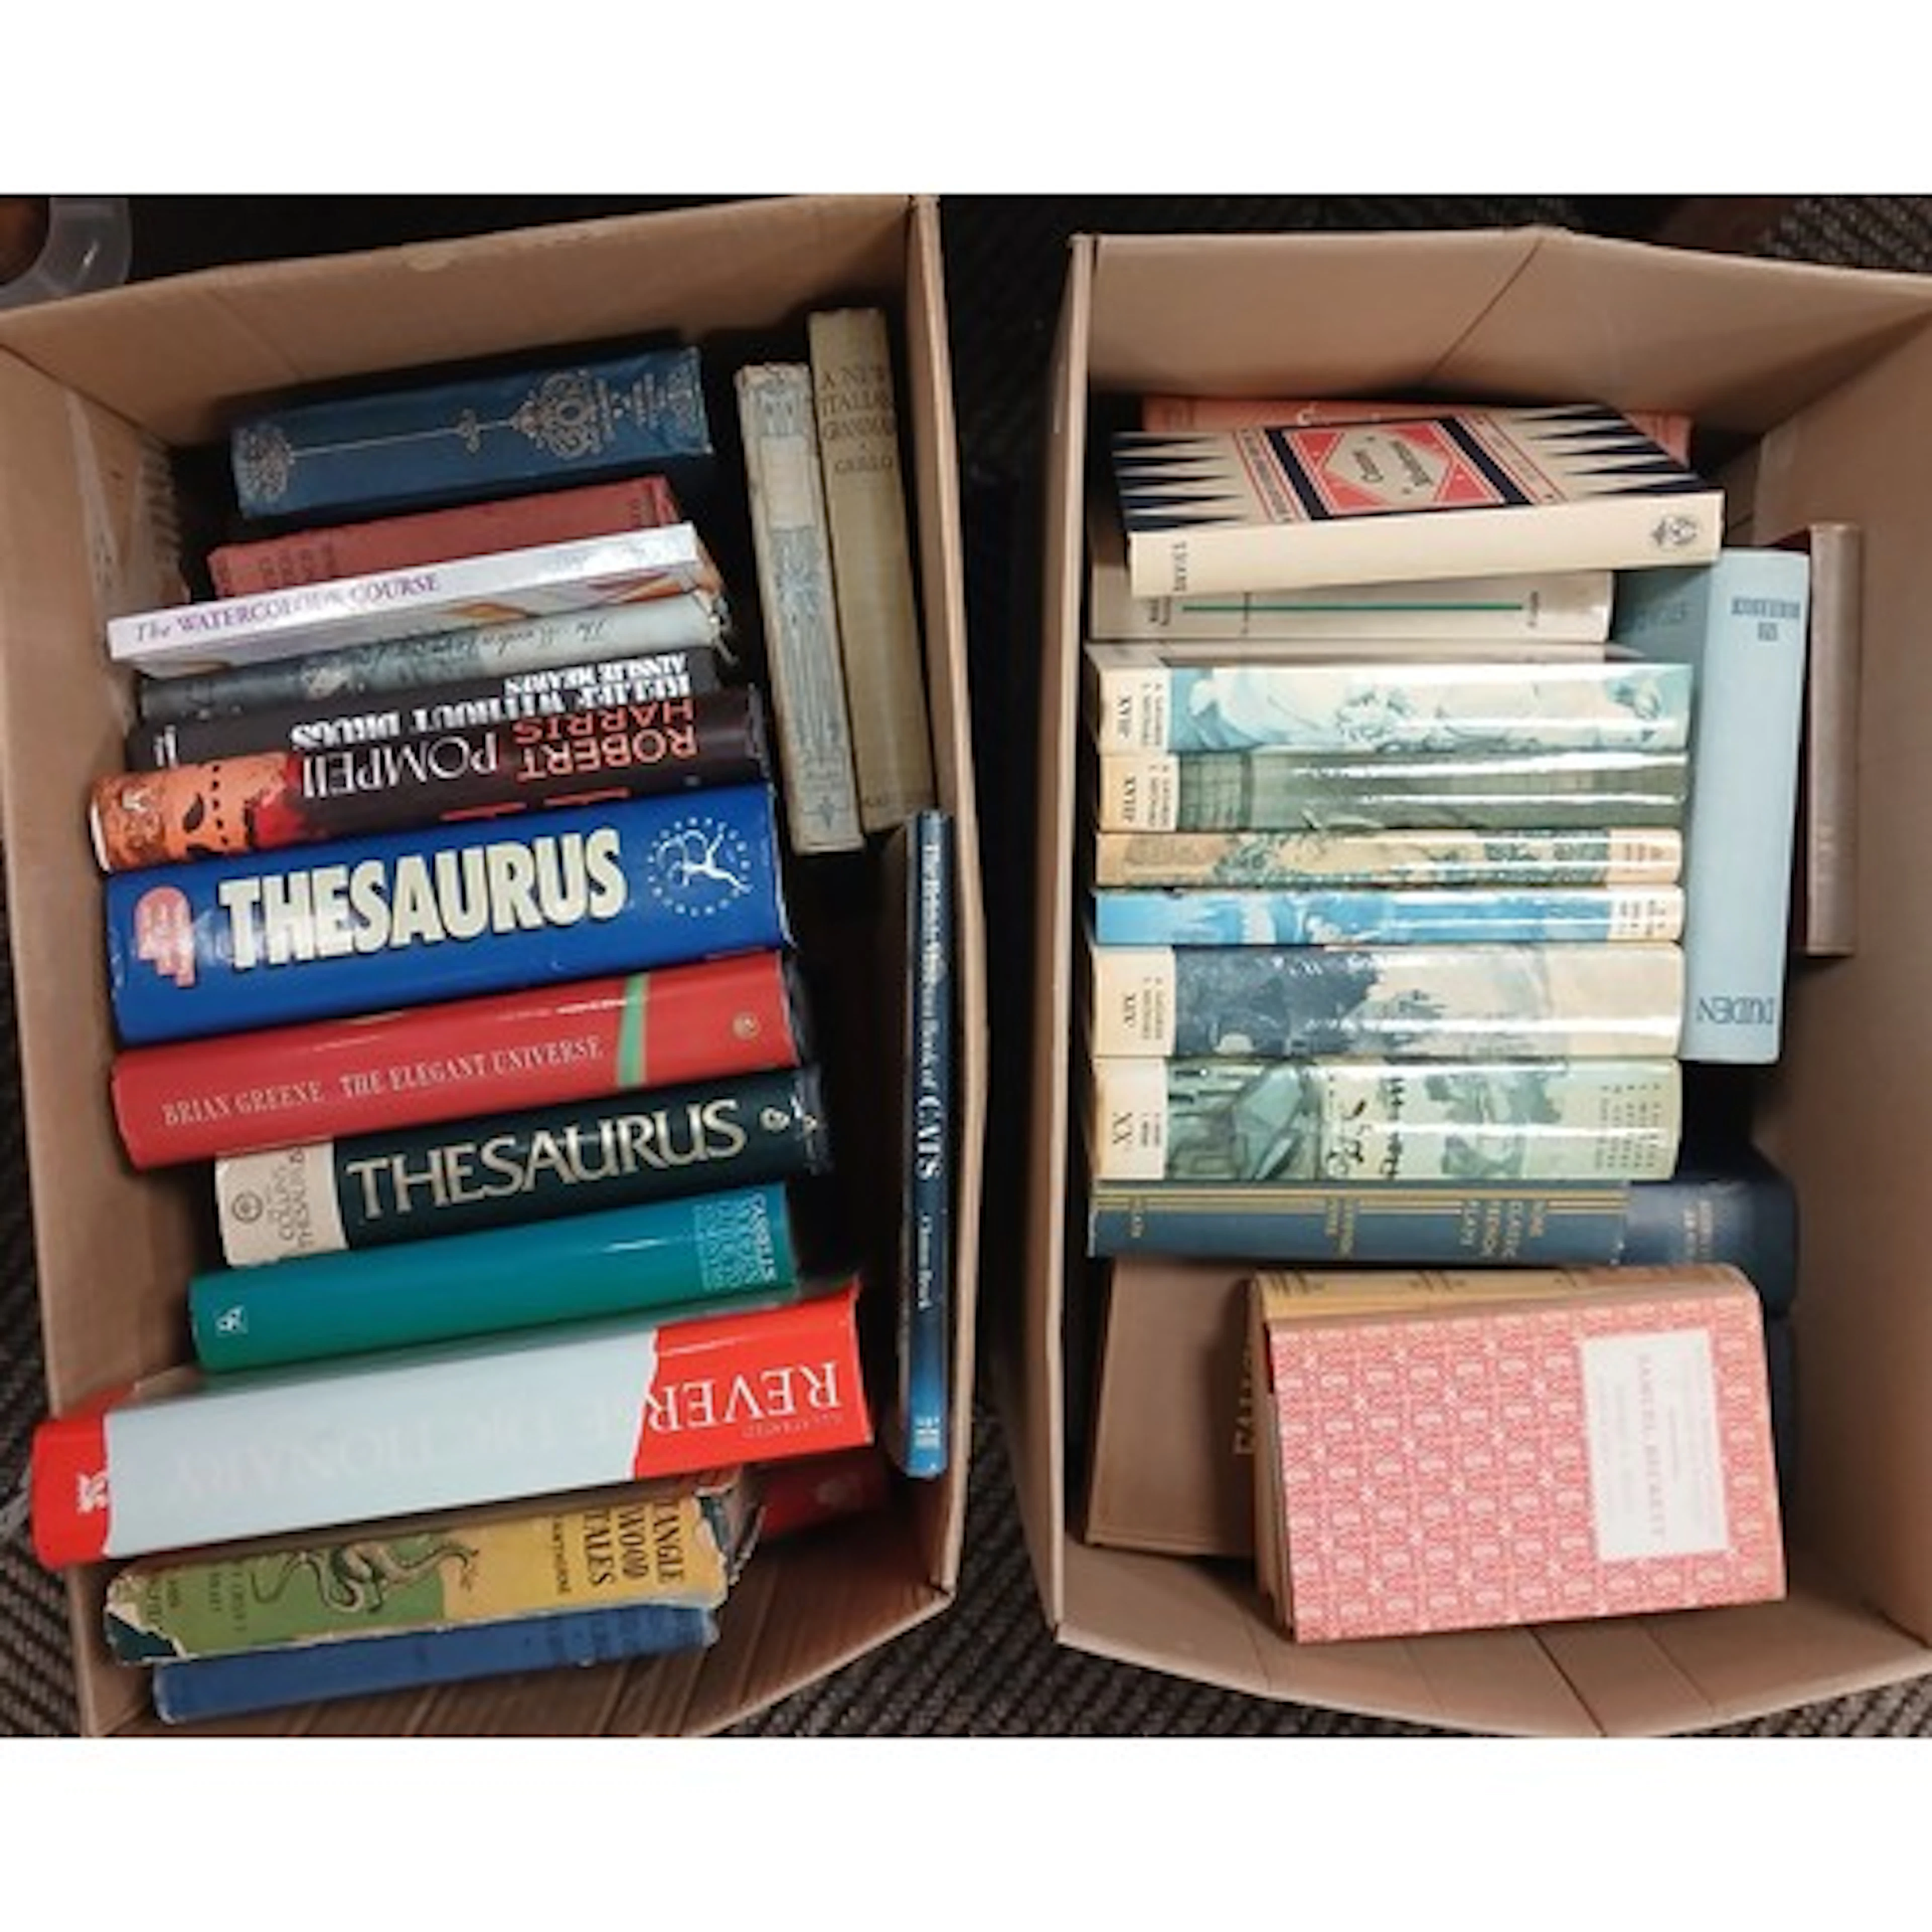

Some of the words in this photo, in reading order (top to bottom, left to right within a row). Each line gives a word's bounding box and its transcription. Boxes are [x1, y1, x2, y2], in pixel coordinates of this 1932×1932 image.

[349, 571, 439, 602] COURSE
[290, 711, 401, 749] DRUGS
[412, 690, 565, 734] WITHOUT
[514, 698, 695, 743] HARRIS
[302, 732, 497, 798] POMPEII
[515, 725, 698, 782] ROBERT
[217, 827, 630, 970] THESAURUS
[162, 1096, 232, 1128] BRIAN
[234, 1080, 324, 1116] GREENE
[340, 1069, 384, 1099] THE
[389, 1054, 489, 1093] ELEGANT
[494, 1034, 604, 1081] UNIVERSE
[344, 1098, 749, 1220] THESAURUS
[915, 1094, 942, 1180] CATS
[580, 1509, 619, 1587] TALES
[613, 1505, 653, 1580] WOOD
